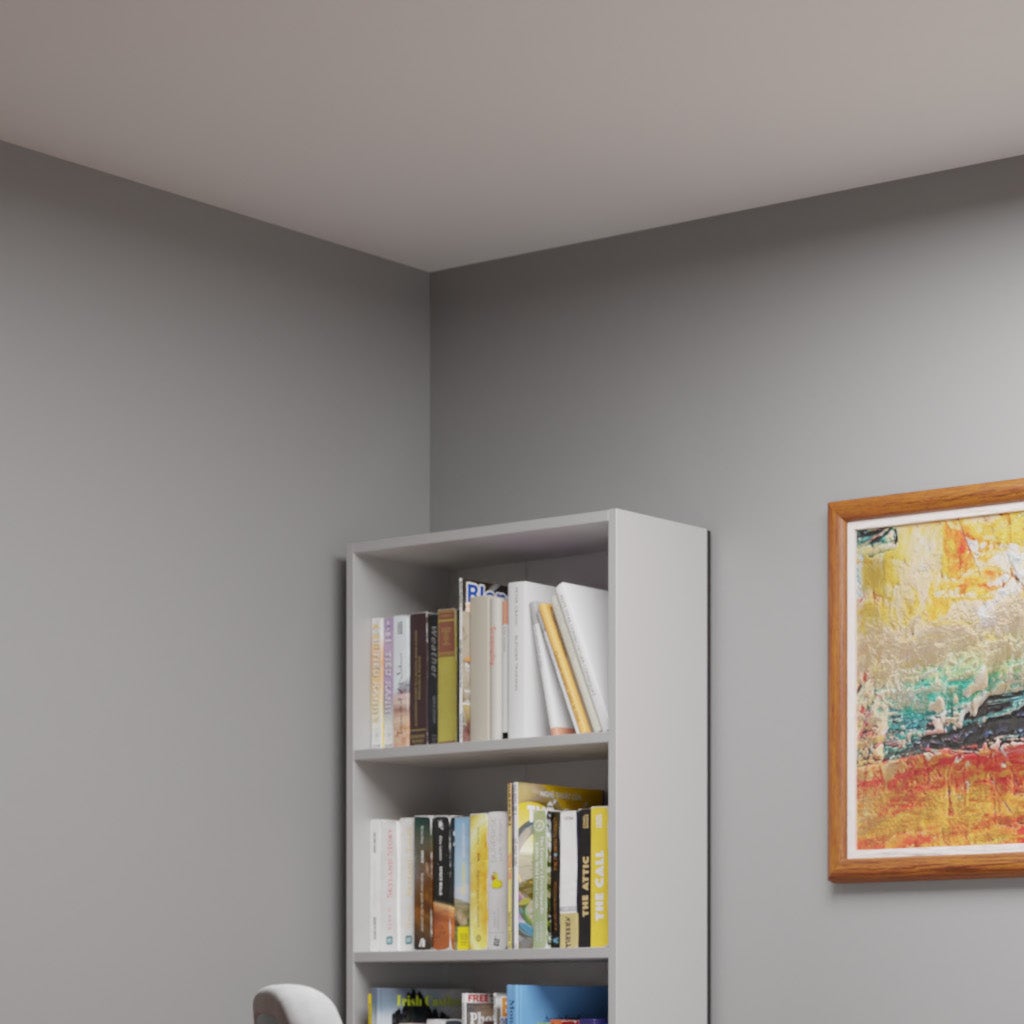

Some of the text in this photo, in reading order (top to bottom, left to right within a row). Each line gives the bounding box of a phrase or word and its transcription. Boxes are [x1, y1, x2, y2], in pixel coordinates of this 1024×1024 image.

[595, 850, 604, 921] THE CALL
[396, 994, 424, 1007] Irish
[468, 994, 489, 1003] FREE
